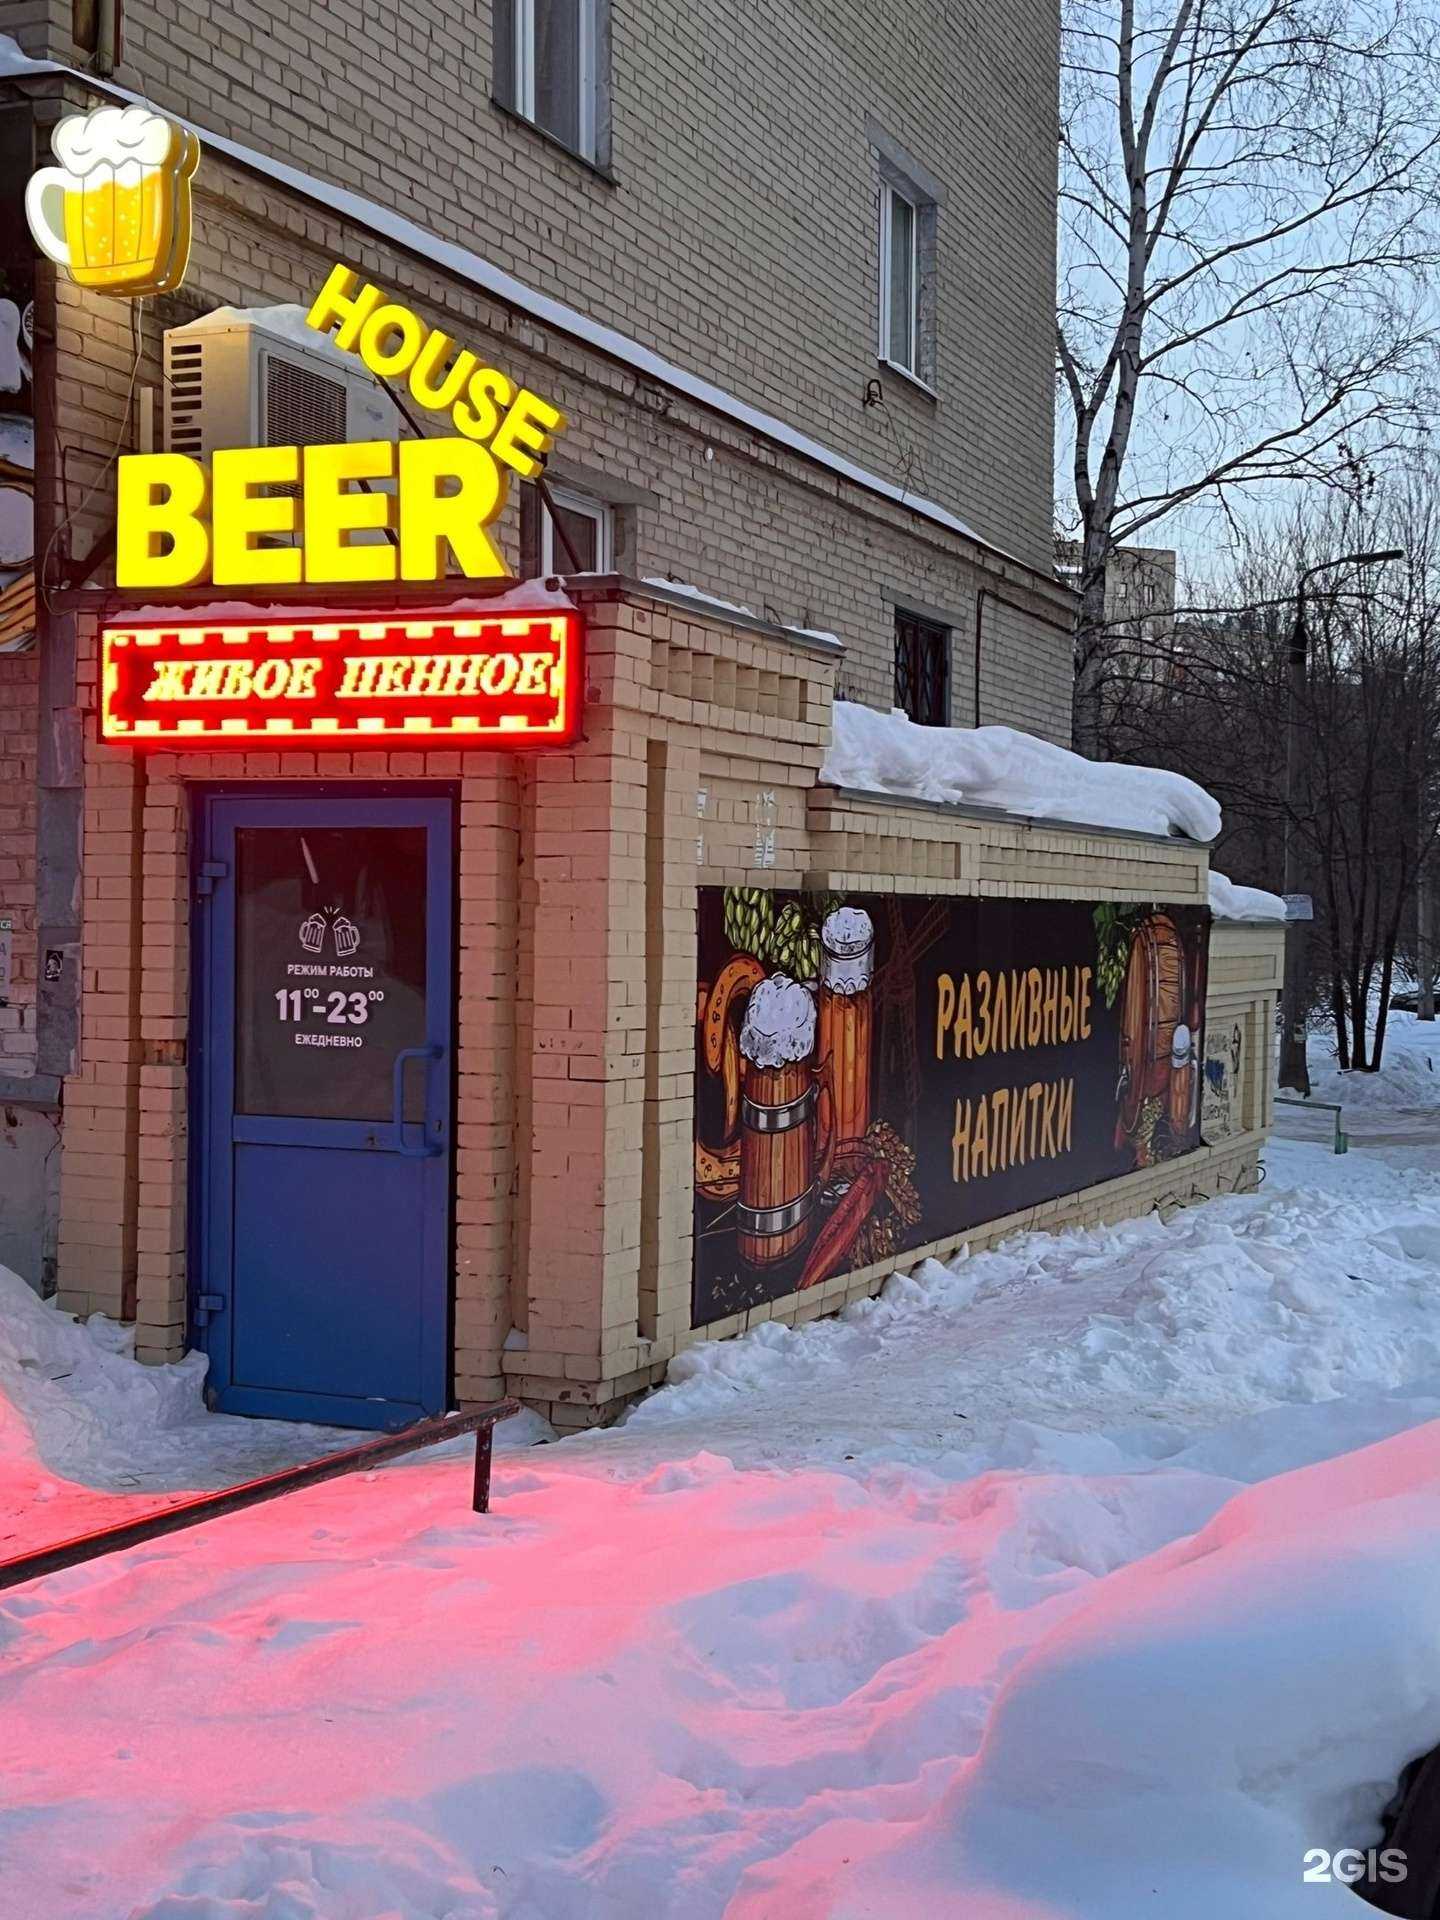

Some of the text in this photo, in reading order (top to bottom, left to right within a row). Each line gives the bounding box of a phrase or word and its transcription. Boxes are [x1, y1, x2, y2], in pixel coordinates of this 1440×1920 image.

[306, 263, 564, 477] HOUSE
[117, 437, 508, 588] BEER
[142, 652, 556, 701] ЖИВОЕ ПЕННОЕ
[287, 964, 374, 978] РЕЖИМ РАБОТЫ
[936, 965, 1092, 1060] РАЗЛИВНЫЕ
[295, 1033, 363, 1048] ЕЖЕДНЕВНО
[952, 1078, 1074, 1183] НАПИТКИ
